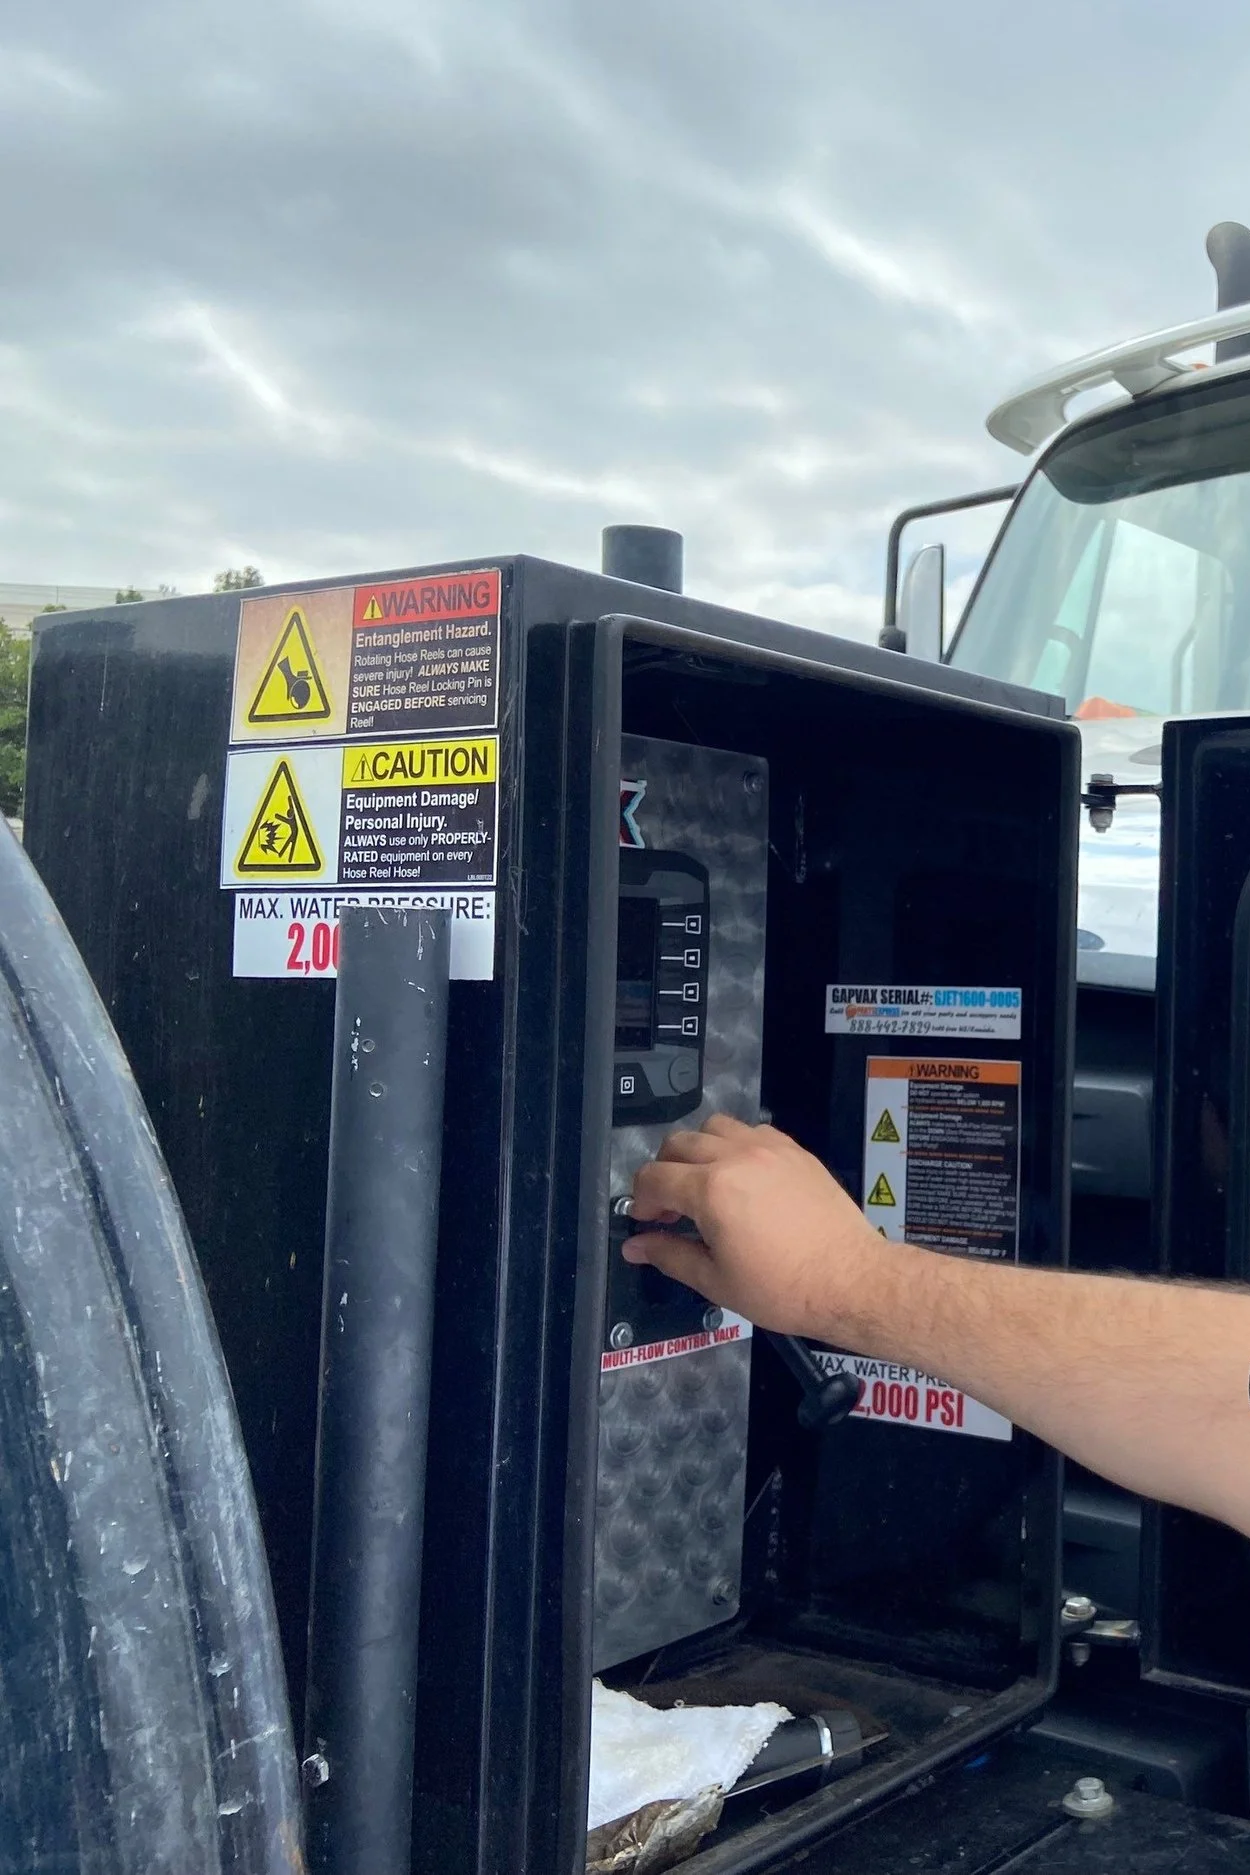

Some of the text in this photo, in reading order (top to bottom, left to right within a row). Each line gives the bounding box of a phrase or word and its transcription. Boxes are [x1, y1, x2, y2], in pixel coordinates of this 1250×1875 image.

[382, 581, 490, 617] WARNING
[356, 621, 491, 648] Entanglement Hazard.
[354, 645, 491, 667] Rotating Hose Reels can cause
[353, 660, 489, 682] severe injury! ALWAYS MAKE
[352, 676, 492, 698] SURE Hose Reel Locking Pin is
[352, 694, 487, 713] ENGAGED BEFORE servicing
[351, 716, 373, 728] Reel!
[372, 746, 488, 780] CAUTION
[347, 789, 479, 812] Equipment Damage/
[345, 813, 447, 832] Personal Injury.
[344, 832, 491, 848] ALWAYS use only PROPERLY-
[344, 850, 473, 864] RATED equipment on every
[343, 866, 420, 878] Hose Reel Hose!
[239, 898, 283, 919] MAX.
[832, 988, 877, 1005] GAPVAX
[850, 1020, 931, 1034] 888-442-7829
[917, 1064, 979, 1079] WARNING
[603, 1325, 740, 1369] MULTI-FLOW CONTROL VALVE
[854, 1360, 909, 1382] WATER
[853, 1378, 919, 1420] 2,000
[926, 1389, 964, 1428] PSI
